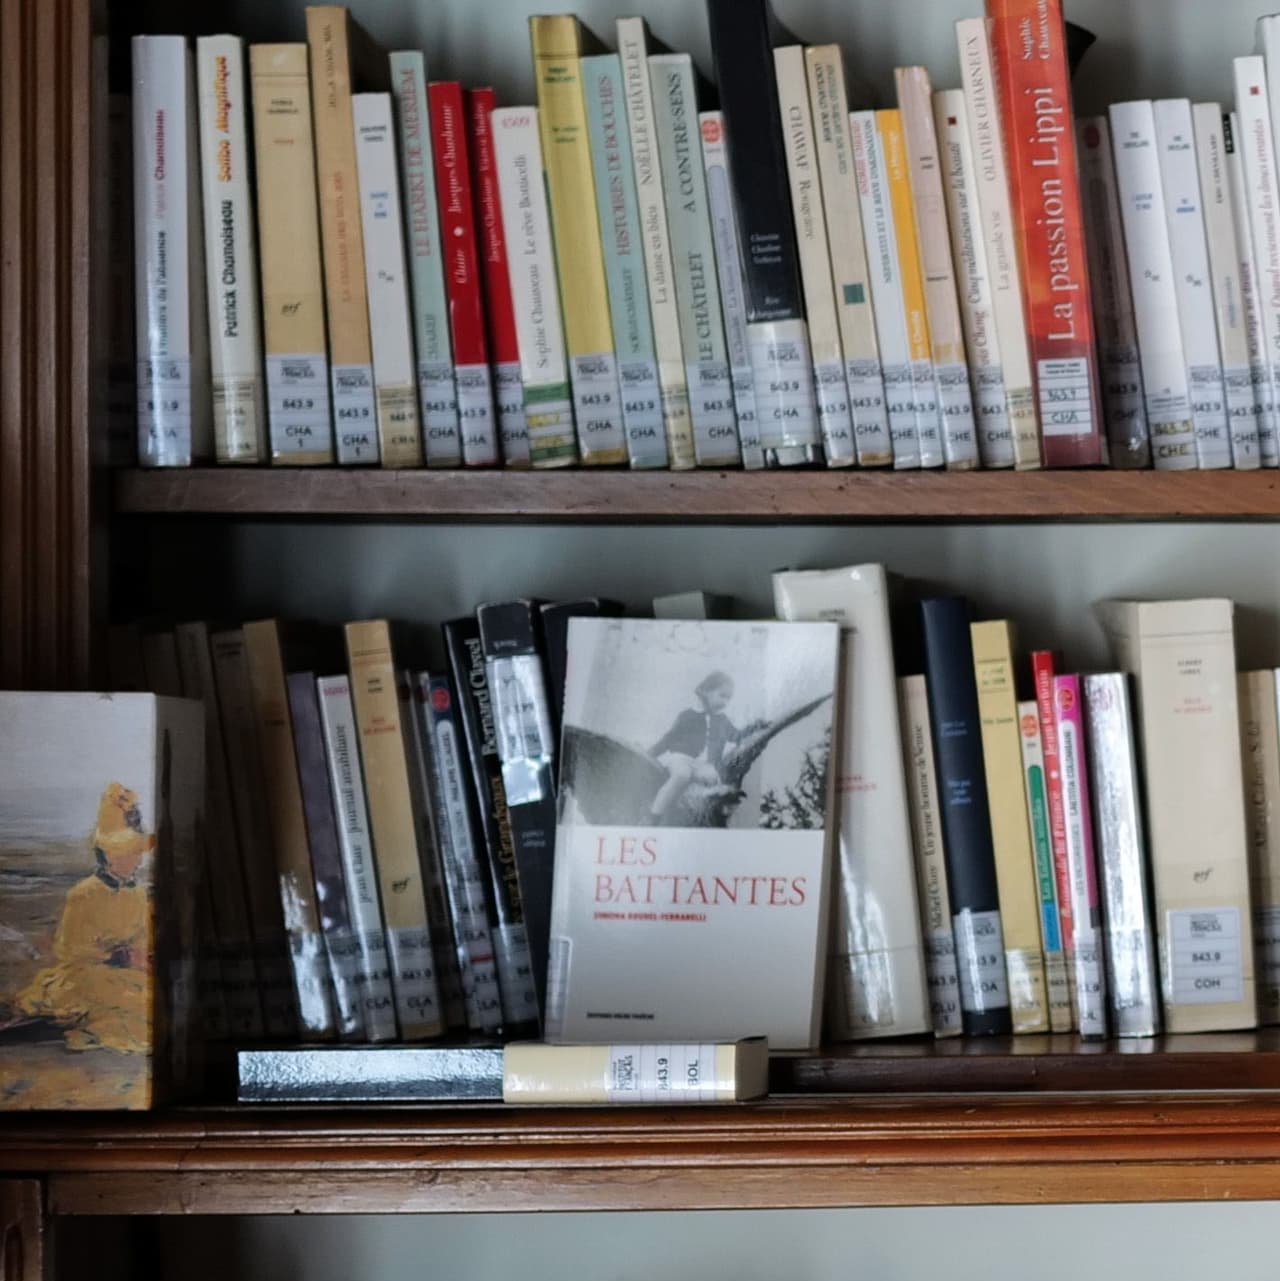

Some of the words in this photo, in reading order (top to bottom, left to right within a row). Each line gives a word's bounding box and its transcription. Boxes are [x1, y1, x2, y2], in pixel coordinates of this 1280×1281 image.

[624, 41, 647, 120] CHÂTELET
[966, 35, 988, 118] CHARNEUX
[406, 145, 421, 166] DE
[631, 124, 653, 185] NOËLLE
[976, 121, 997, 181] OLIVIER
[1024, 87, 1062, 165] Lippi
[605, 153, 621, 171] DE
[408, 173, 429, 232] HARKI
[608, 175, 630, 256] HISTOIRES
[222, 199, 236, 285] Chamoiseau
[414, 235, 431, 257] LE
[1036, 179, 1074, 292] passion
[223, 290, 237, 338] Patrick
[687, 250, 709, 339] CHÂTELET
[1047, 302, 1075, 340] La
[466, 638, 486, 688] Clavel
[474, 690, 496, 754] Bernard
[596, 837, 658, 866] LES
[594, 875, 807, 907] BATTANTES
[1194, 978, 1221, 989] COH
[688, 1060, 699, 1086] BOL
